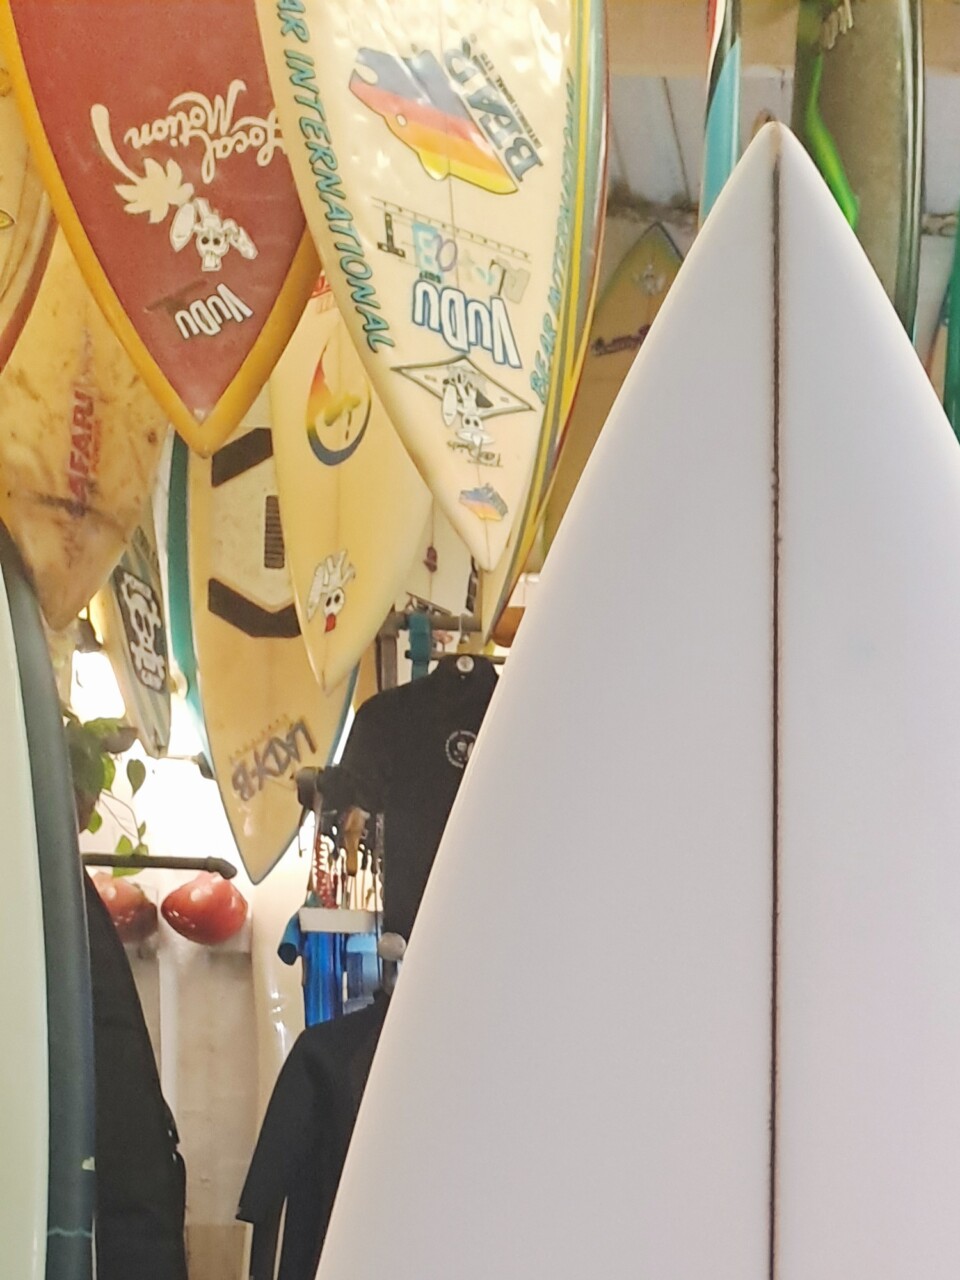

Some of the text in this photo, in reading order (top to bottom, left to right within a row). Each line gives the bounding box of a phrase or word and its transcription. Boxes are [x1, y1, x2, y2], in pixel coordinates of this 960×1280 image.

[124, 79, 247, 150] Motion
[191, 107, 288, 185] Local
[284, 49, 396, 354] INTERNATIONAL
